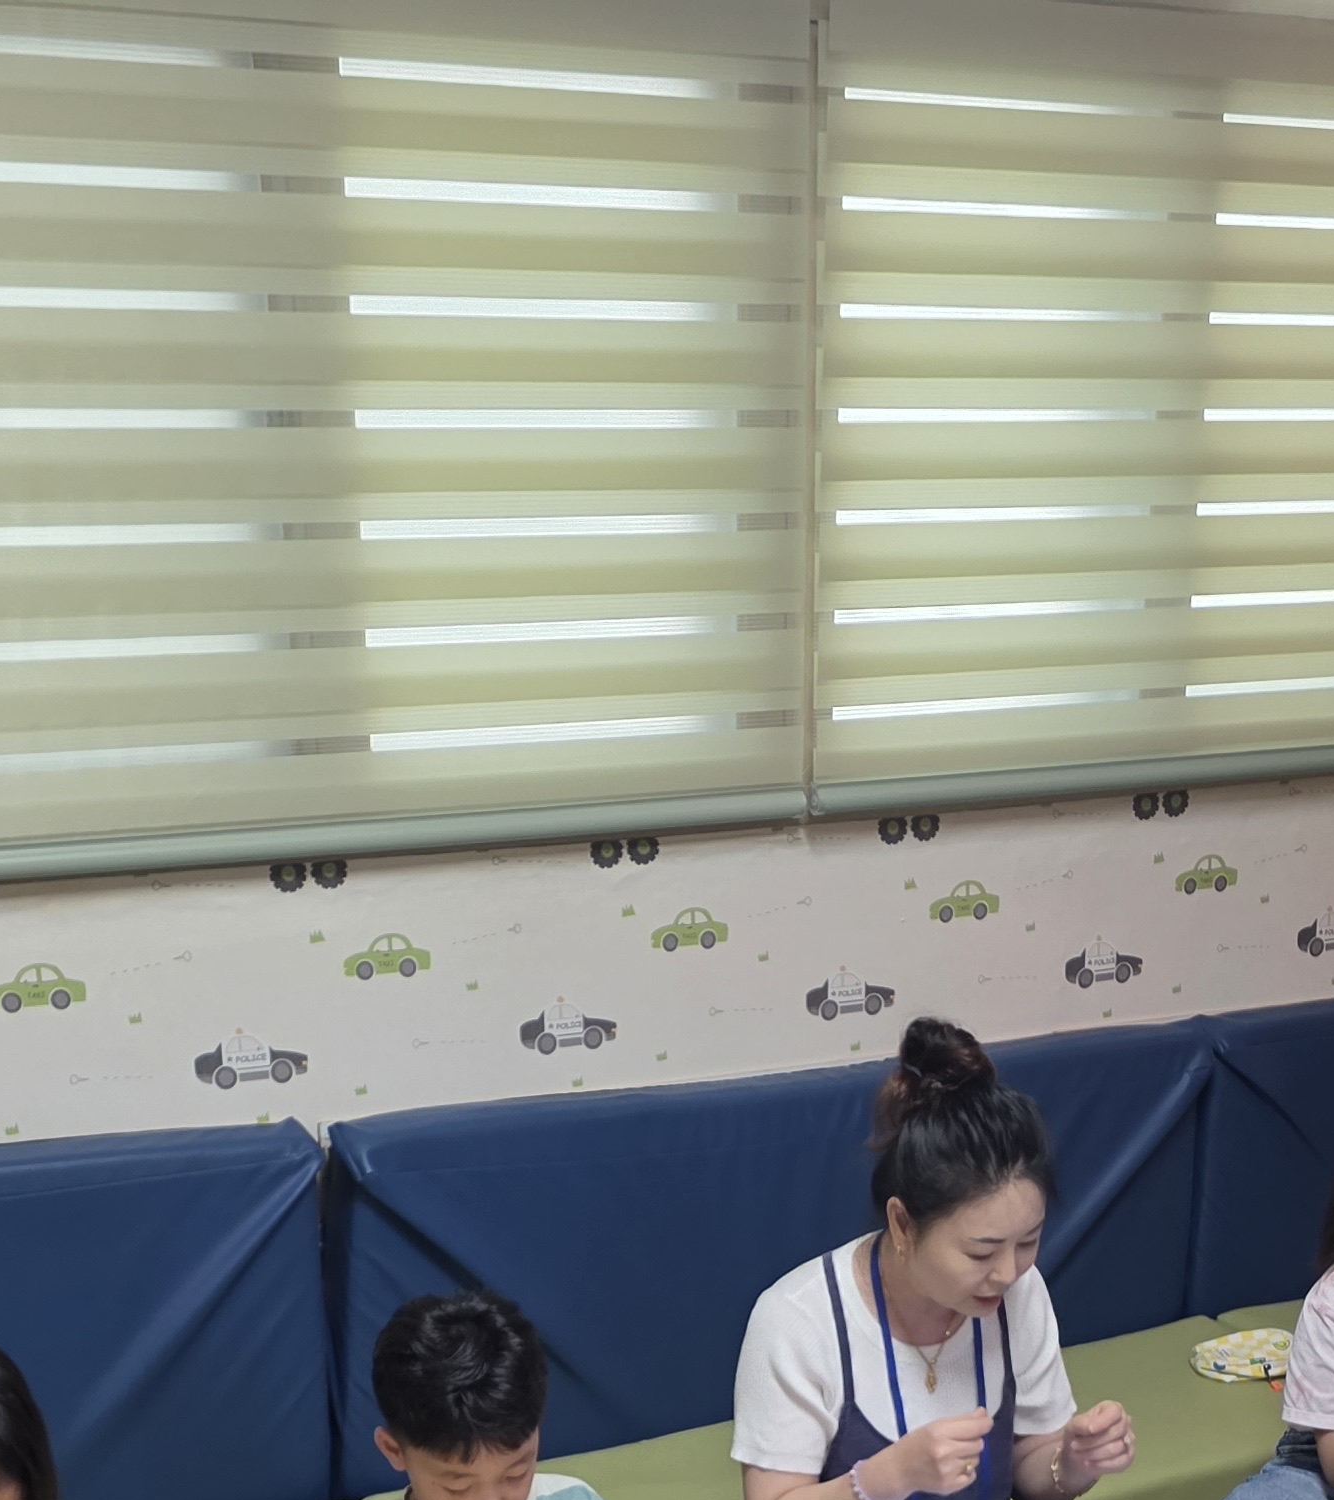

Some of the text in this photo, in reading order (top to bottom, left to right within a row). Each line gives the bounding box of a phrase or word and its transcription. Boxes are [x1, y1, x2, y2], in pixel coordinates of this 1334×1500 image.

[838, 988, 863, 997] POLICE
[556, 1021, 582, 1030] POLICE
[236, 1053, 267, 1063] POLICE
